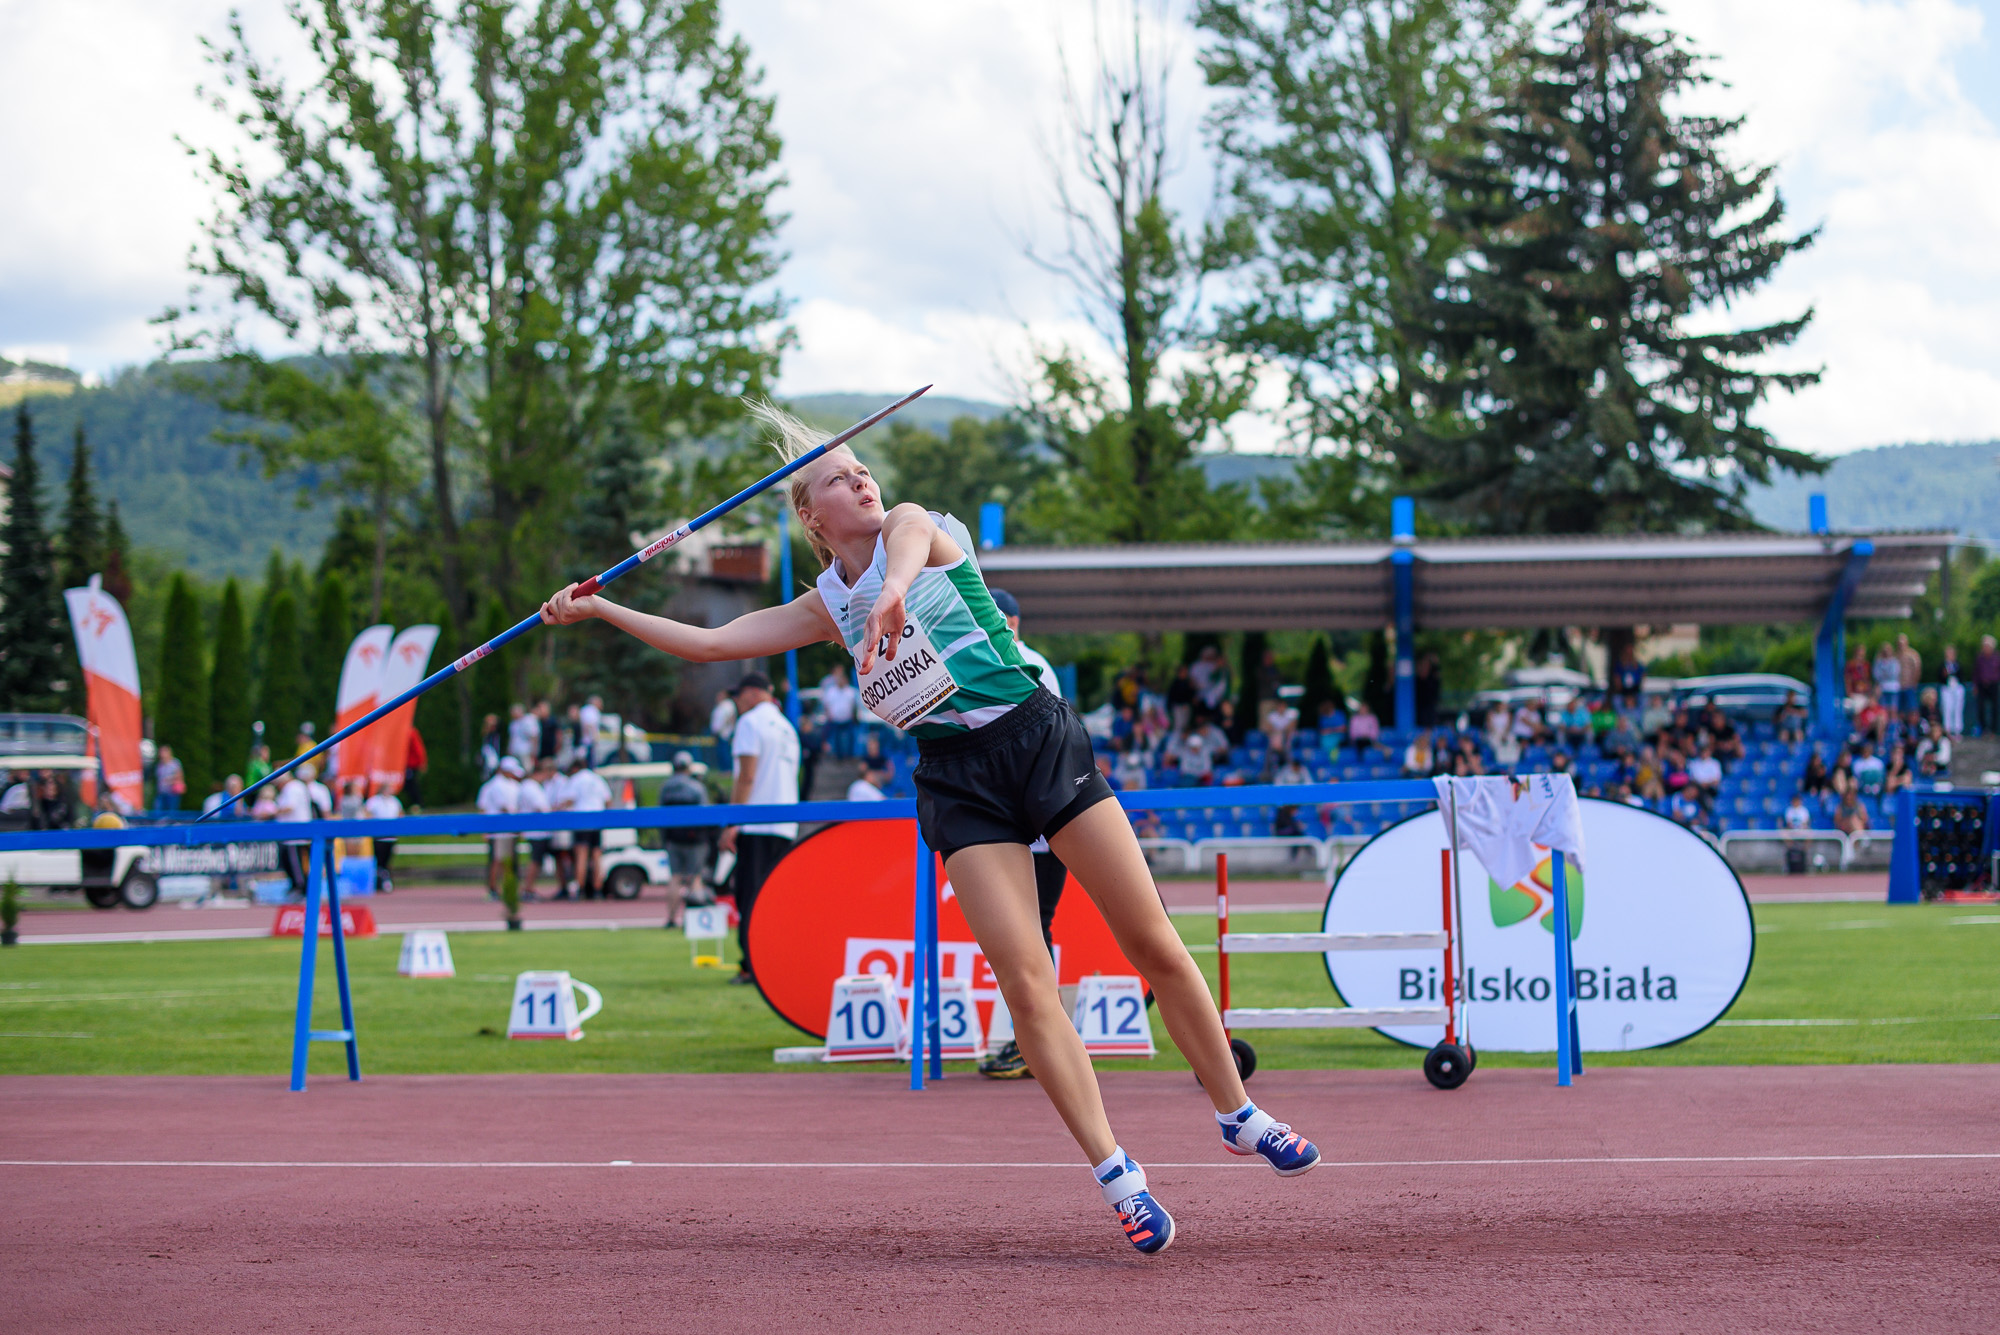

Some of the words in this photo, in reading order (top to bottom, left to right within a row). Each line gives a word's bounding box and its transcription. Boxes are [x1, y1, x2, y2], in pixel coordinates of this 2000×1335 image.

[644, 533, 674, 557] polanik
[861, 648, 937, 711] SOBOLEWSKA
[920, 686, 939, 702] Polski
[939, 676, 952, 688] U18
[420, 944, 444, 967] 11
[520, 991, 557, 1026] 11
[835, 999, 886, 1041] 10
[1090, 995, 1141, 1036] 12
